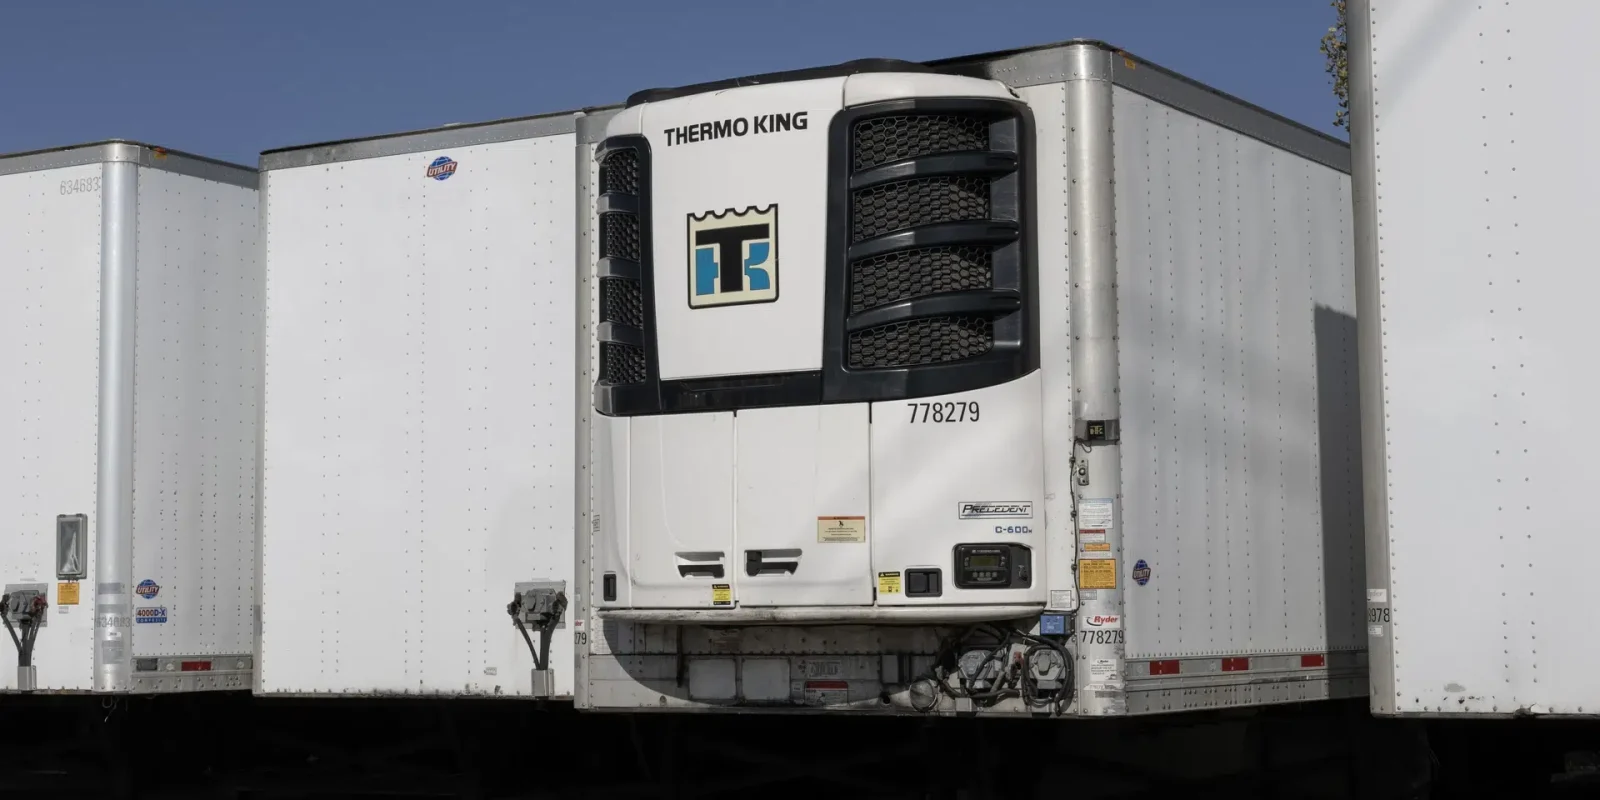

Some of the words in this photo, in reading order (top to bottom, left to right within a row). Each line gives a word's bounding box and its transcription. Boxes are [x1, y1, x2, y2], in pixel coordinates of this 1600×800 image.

[664, 117, 749, 147] THERMO
[753, 111, 808, 134] KING
[428, 163, 456, 176] UTILITY
[60, 176, 99, 195] 634683
[907, 401, 980, 424] 778279
[962, 504, 1031, 514] PRECEDENT
[1133, 569, 1150, 579] UTILITY
[137, 586, 159, 594] UTILITY
[137, 609, 166, 617] 4000D-X
[1094, 615, 1119, 625] Ryder
[1080, 629, 1124, 644] 778279
